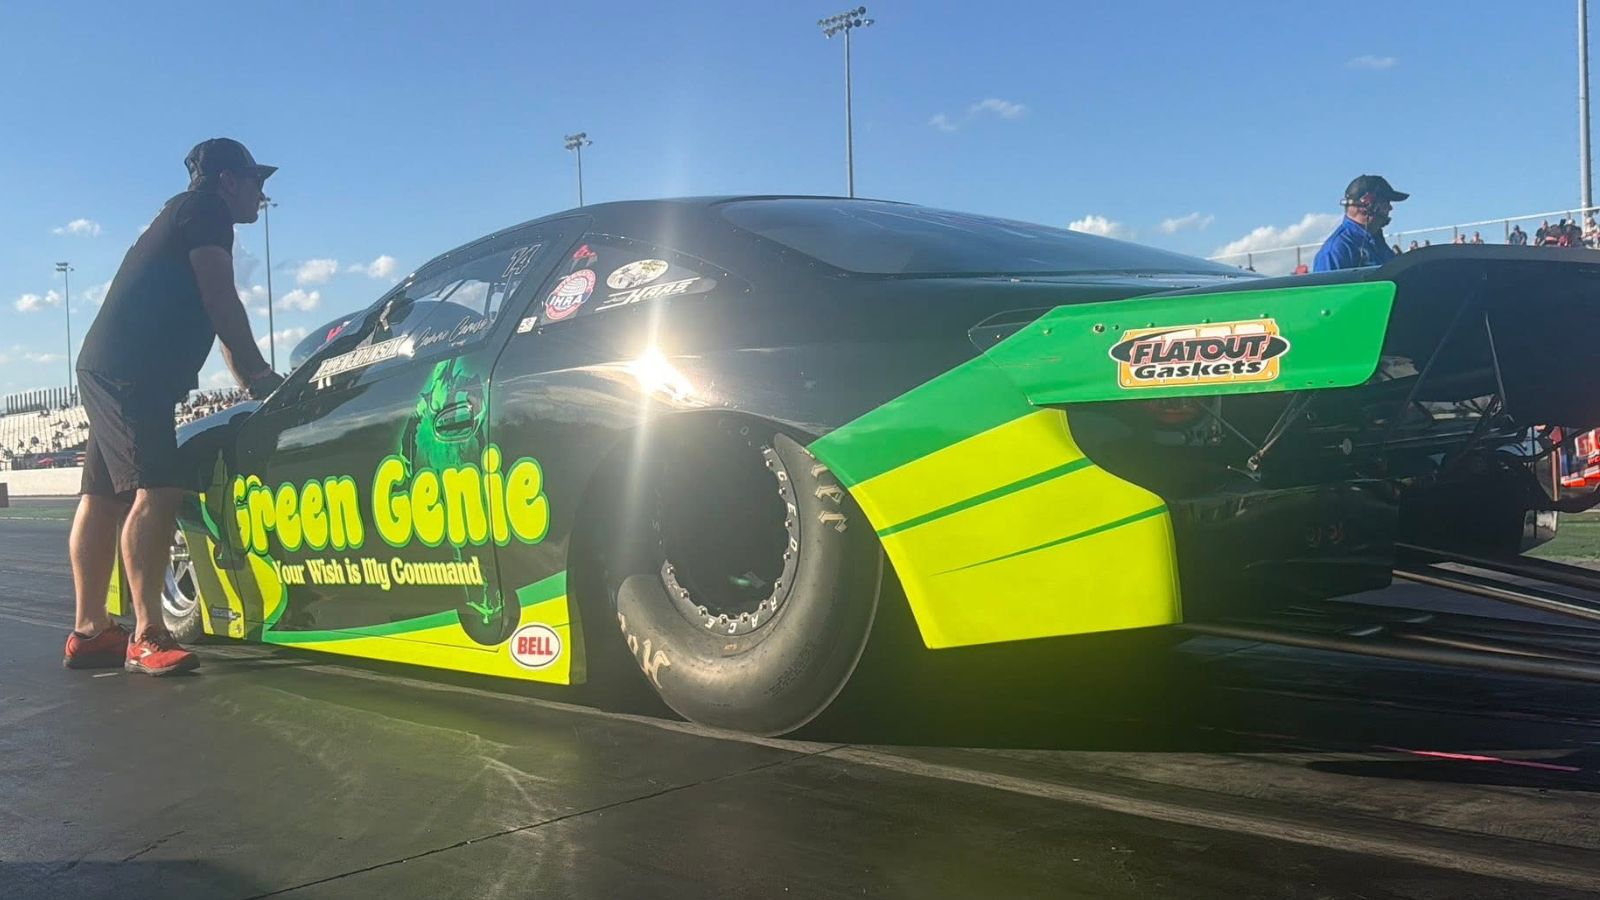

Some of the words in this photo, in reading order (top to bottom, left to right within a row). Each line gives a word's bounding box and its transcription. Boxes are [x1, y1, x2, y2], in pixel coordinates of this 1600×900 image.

[550, 294, 582, 307] IHRA
[1131, 334, 1270, 366] FLATOUT
[1134, 360, 1262, 379] Gaskets
[233, 474, 365, 555] Green
[372, 443, 549, 547] Genie
[272, 560, 306, 585] Your
[305, 558, 346, 585] Wish
[345, 557, 362, 585] is
[361, 558, 391, 591] My
[390, 556, 484, 586] Command
[517, 636, 553, 656] BELL
